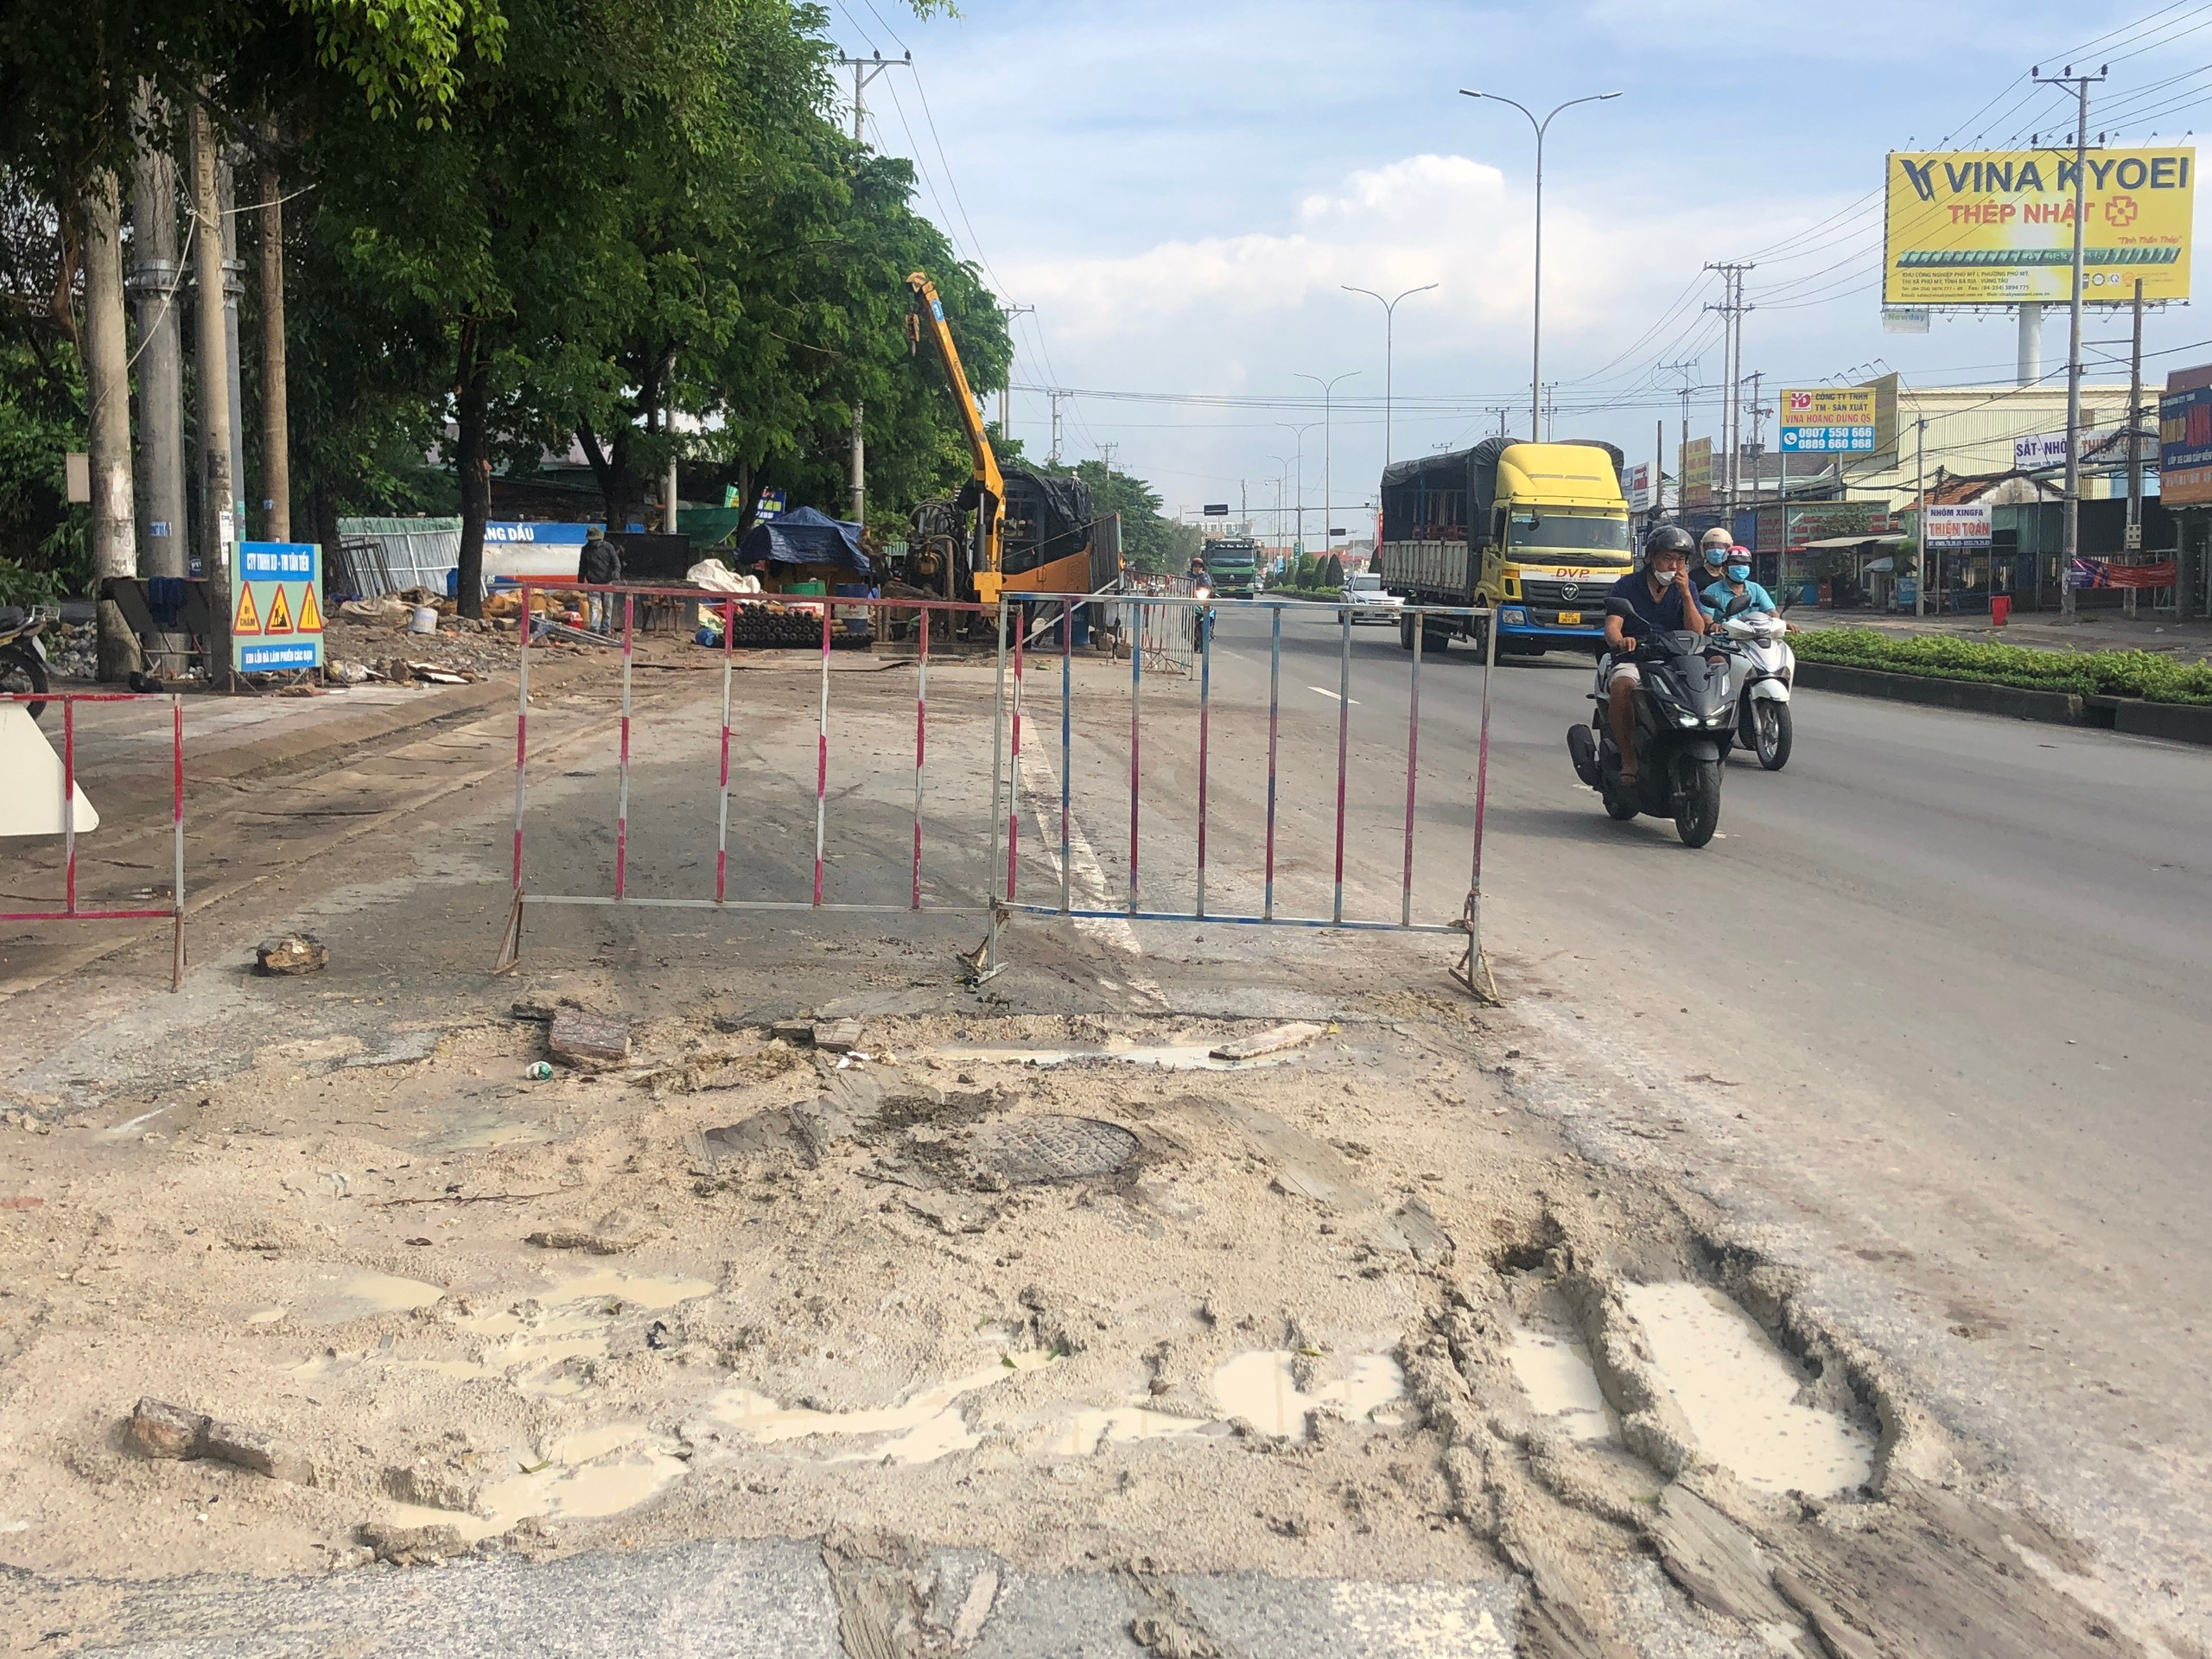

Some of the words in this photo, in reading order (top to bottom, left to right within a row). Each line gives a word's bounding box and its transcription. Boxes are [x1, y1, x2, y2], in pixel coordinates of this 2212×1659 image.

[1944, 161, 2044, 193] VINA
[2057, 156, 2190, 191] KYOEI
[1947, 200, 2016, 225] THÉP
[2024, 198, 2095, 228] NHẬT
[1815, 391, 1836, 401] CÔNG
[1849, 401, 1868, 411] XUẤT
[1785, 415, 1803, 423] VINA
[1798, 428, 1826, 437] 0907
[1828, 428, 1849, 437] 550
[1852, 427, 1872, 437] 666
[1798, 439, 1825, 448] 0889
[1828, 439, 1848, 448] 660
[1852, 438, 1872, 448] 968
[2044, 437, 2067, 455] NHÔ
[484, 527, 506, 541] NG
[507, 523, 535, 541] DẦU
[1556, 568, 1590, 578] DVP
